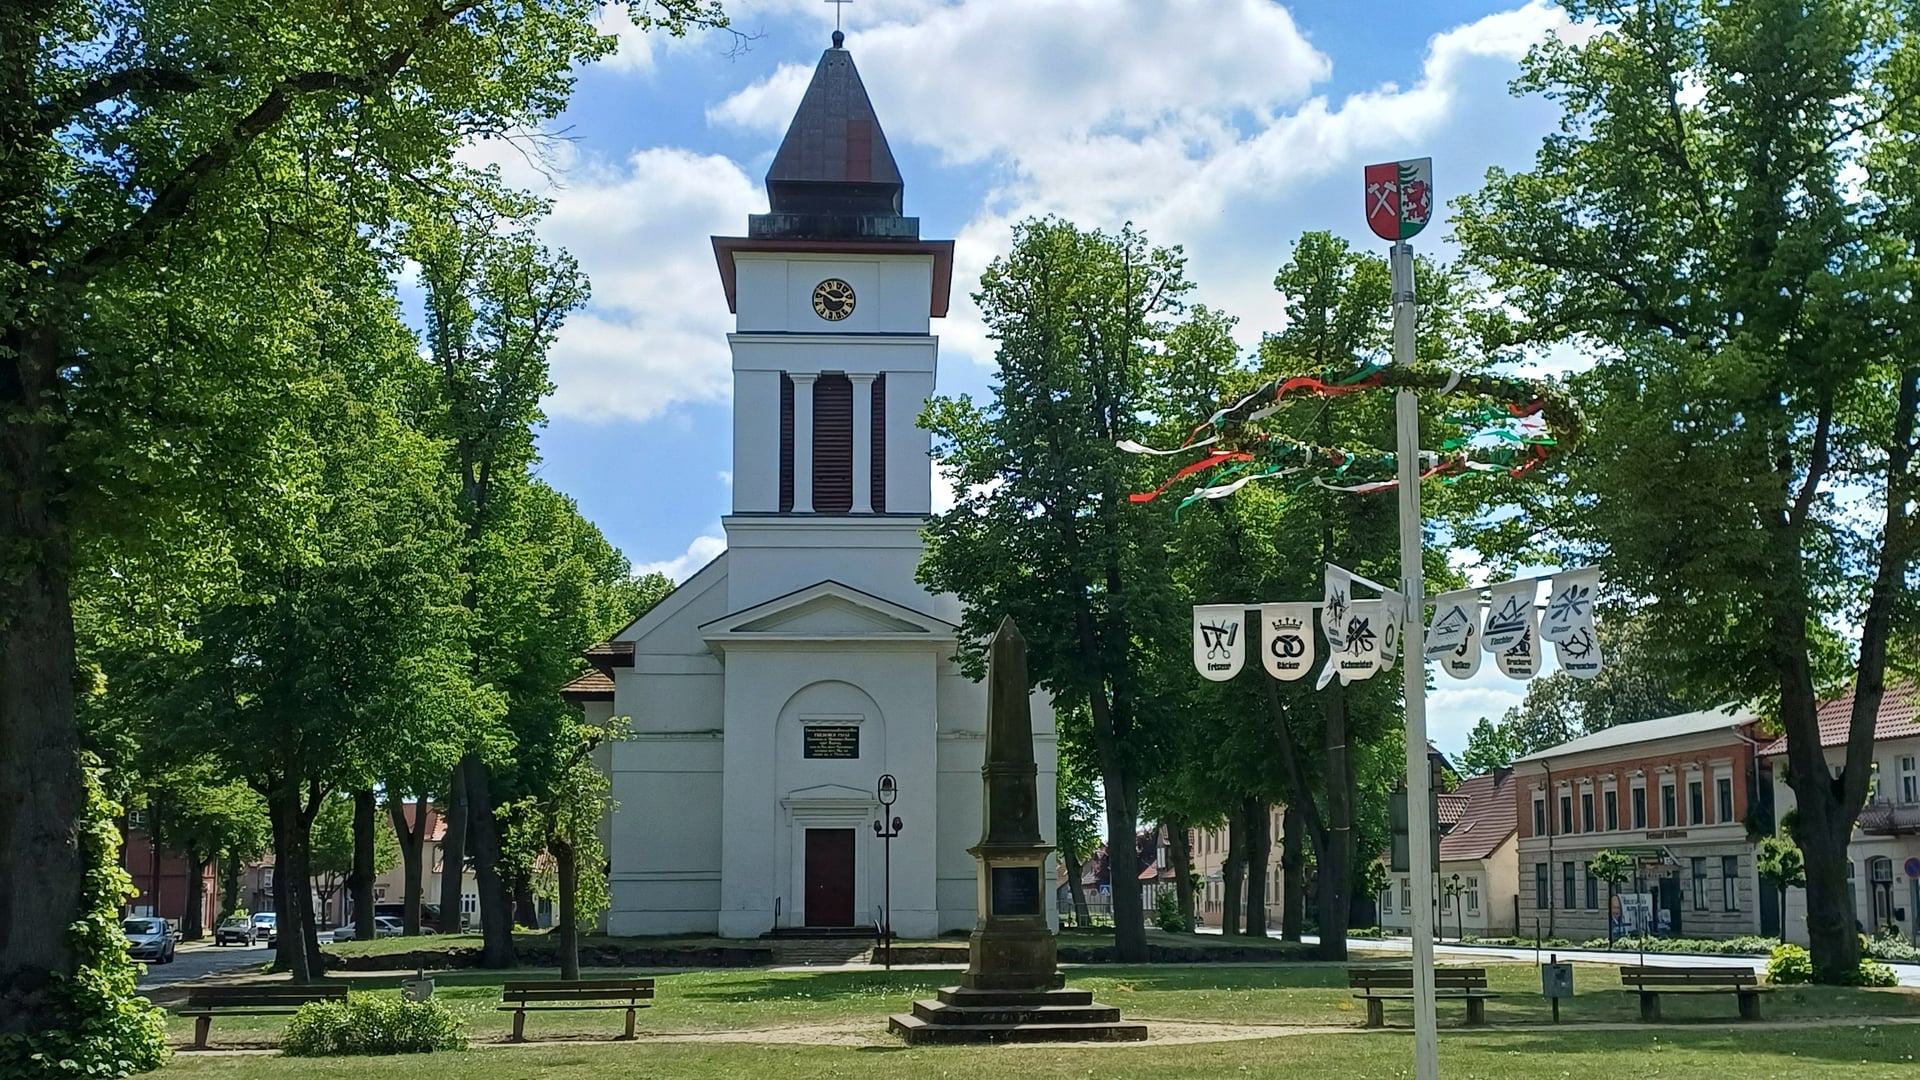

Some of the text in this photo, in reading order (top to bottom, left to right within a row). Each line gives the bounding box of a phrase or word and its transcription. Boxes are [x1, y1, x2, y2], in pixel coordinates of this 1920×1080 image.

[1490, 635, 1514, 646] Tischler
[1276, 661, 1301, 670] Bäcker
[1340, 660, 1374, 669] Schneider
